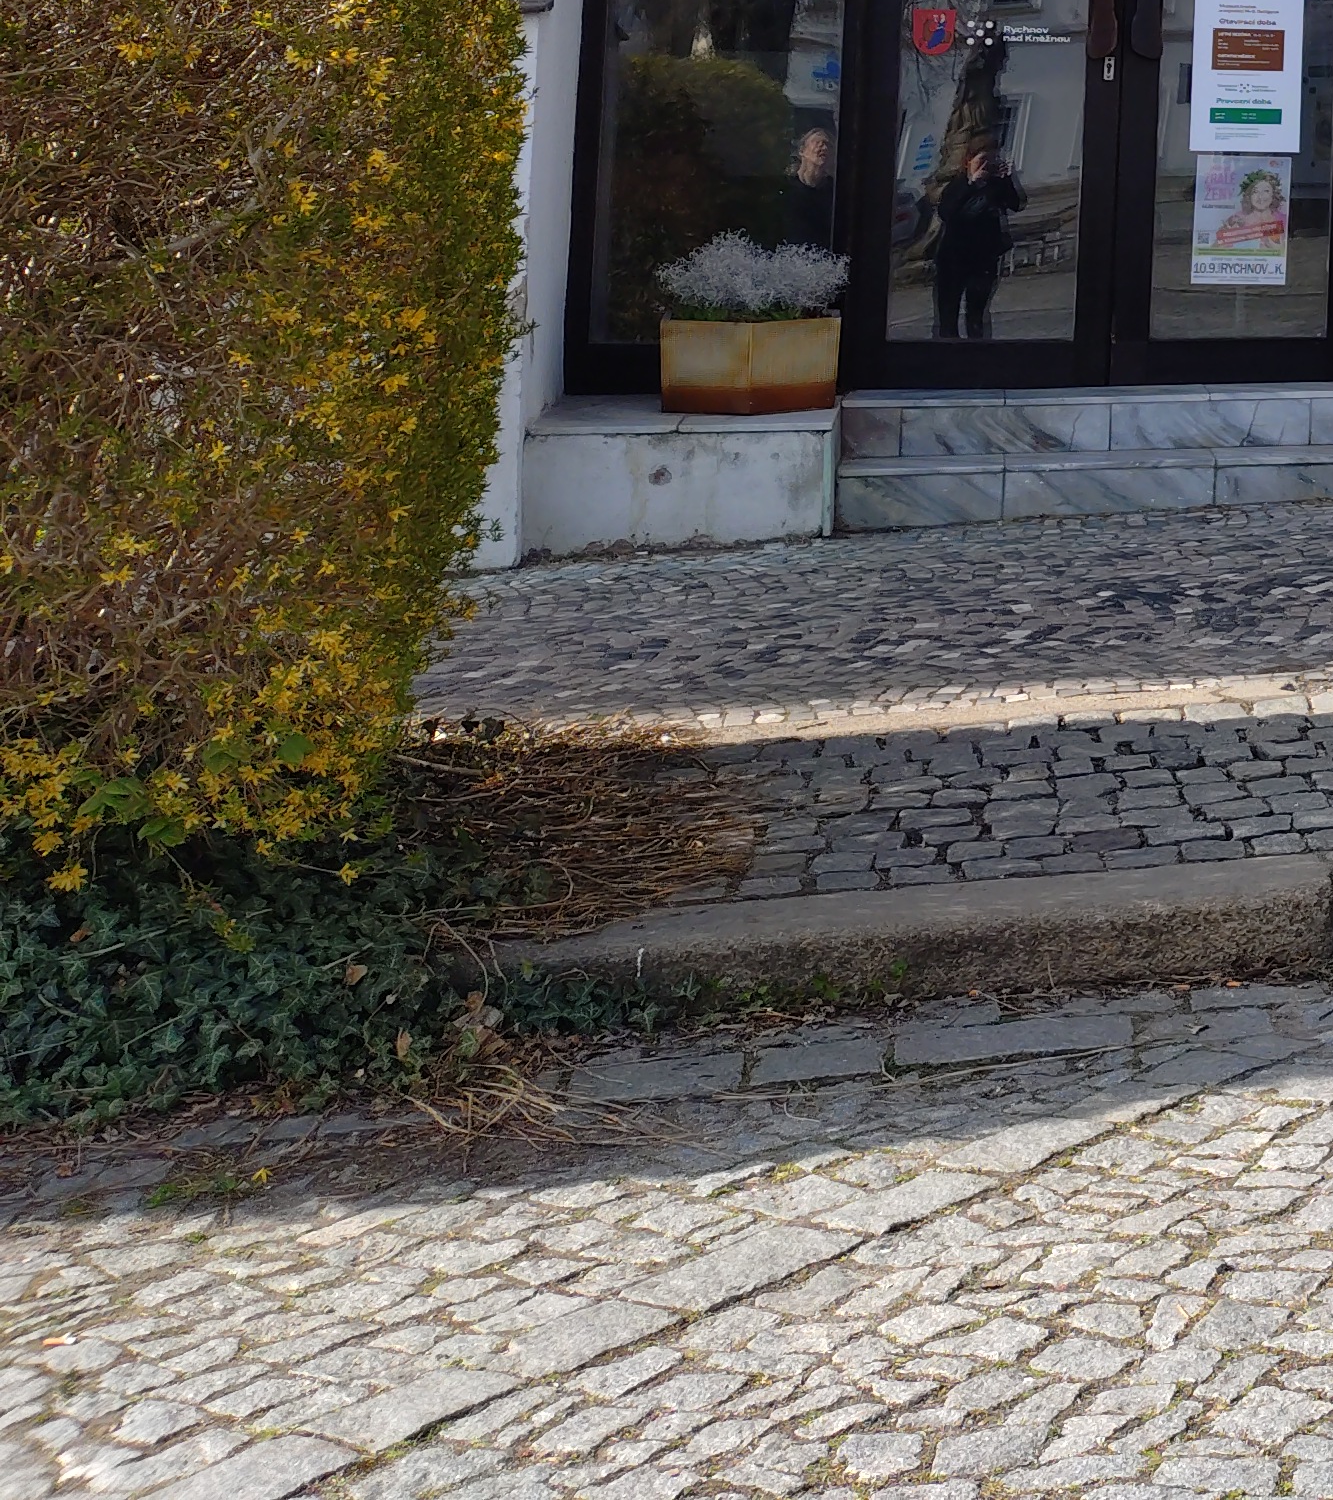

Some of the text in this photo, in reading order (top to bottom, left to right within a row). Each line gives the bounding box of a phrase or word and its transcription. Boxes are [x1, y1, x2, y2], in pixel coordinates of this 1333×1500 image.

[1003, 25, 1049, 36] Rychnov
[1003, 34, 1024, 43] nad
[1220, 263, 1268, 275] RYCHNOV
